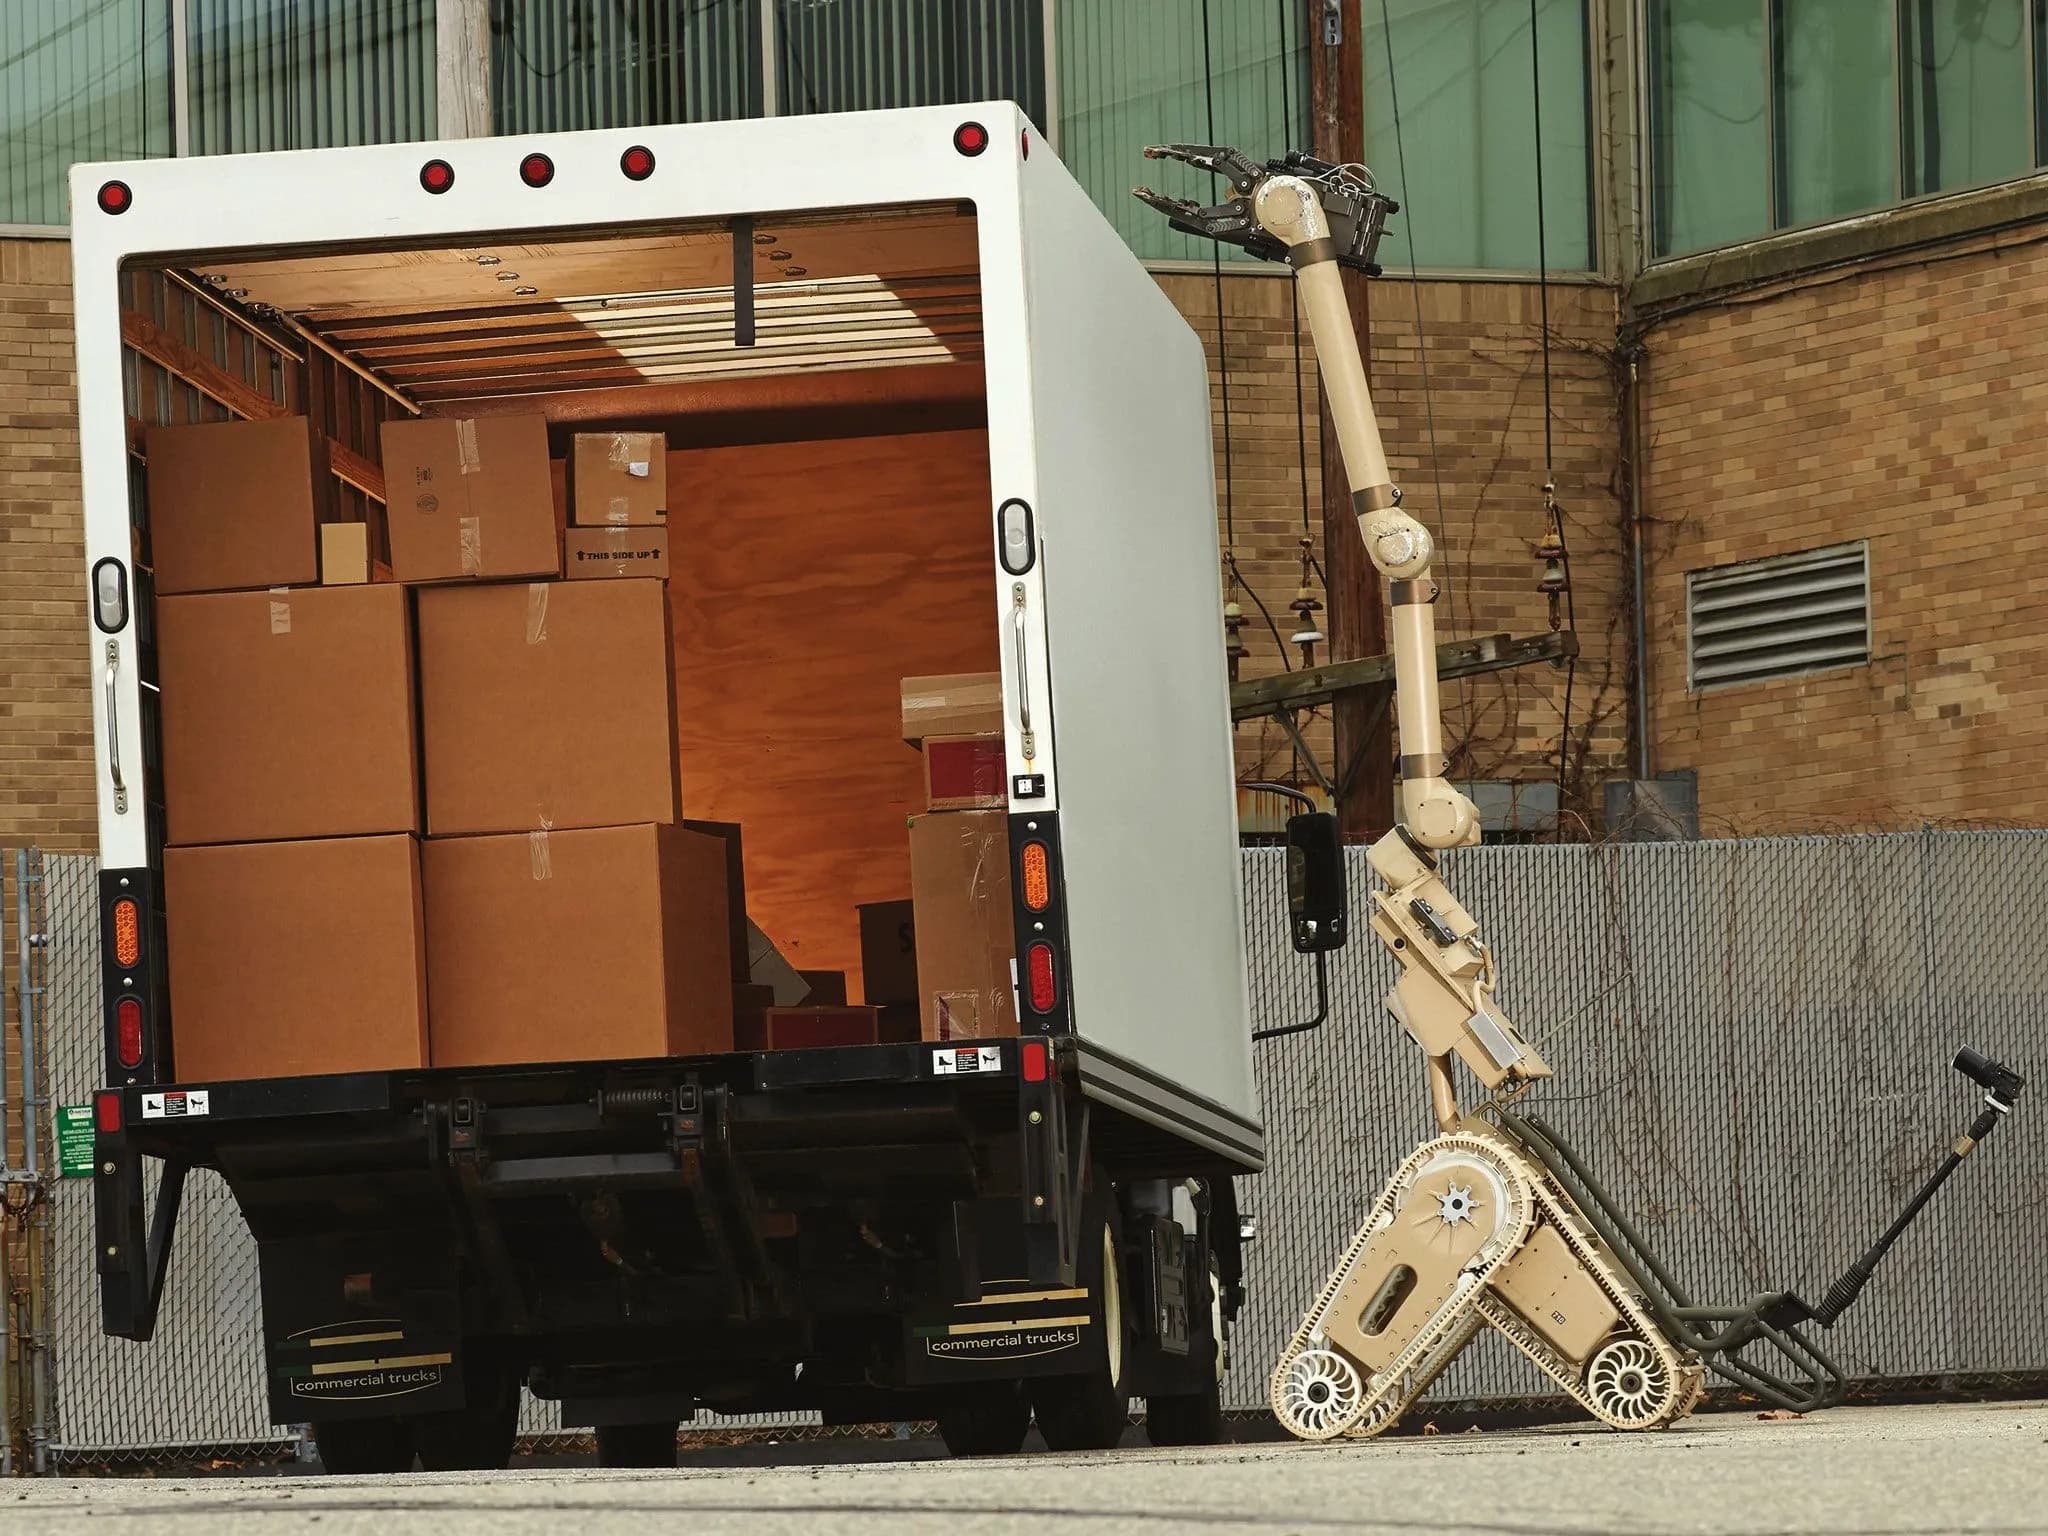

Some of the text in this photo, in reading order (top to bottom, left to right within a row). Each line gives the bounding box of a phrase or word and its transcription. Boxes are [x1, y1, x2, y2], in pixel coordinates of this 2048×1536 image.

[587, 551, 650, 560] THIS SIDE UP
[931, 1330, 1075, 1351] commercial trucks
[296, 1369, 437, 1391] commercial trucks
